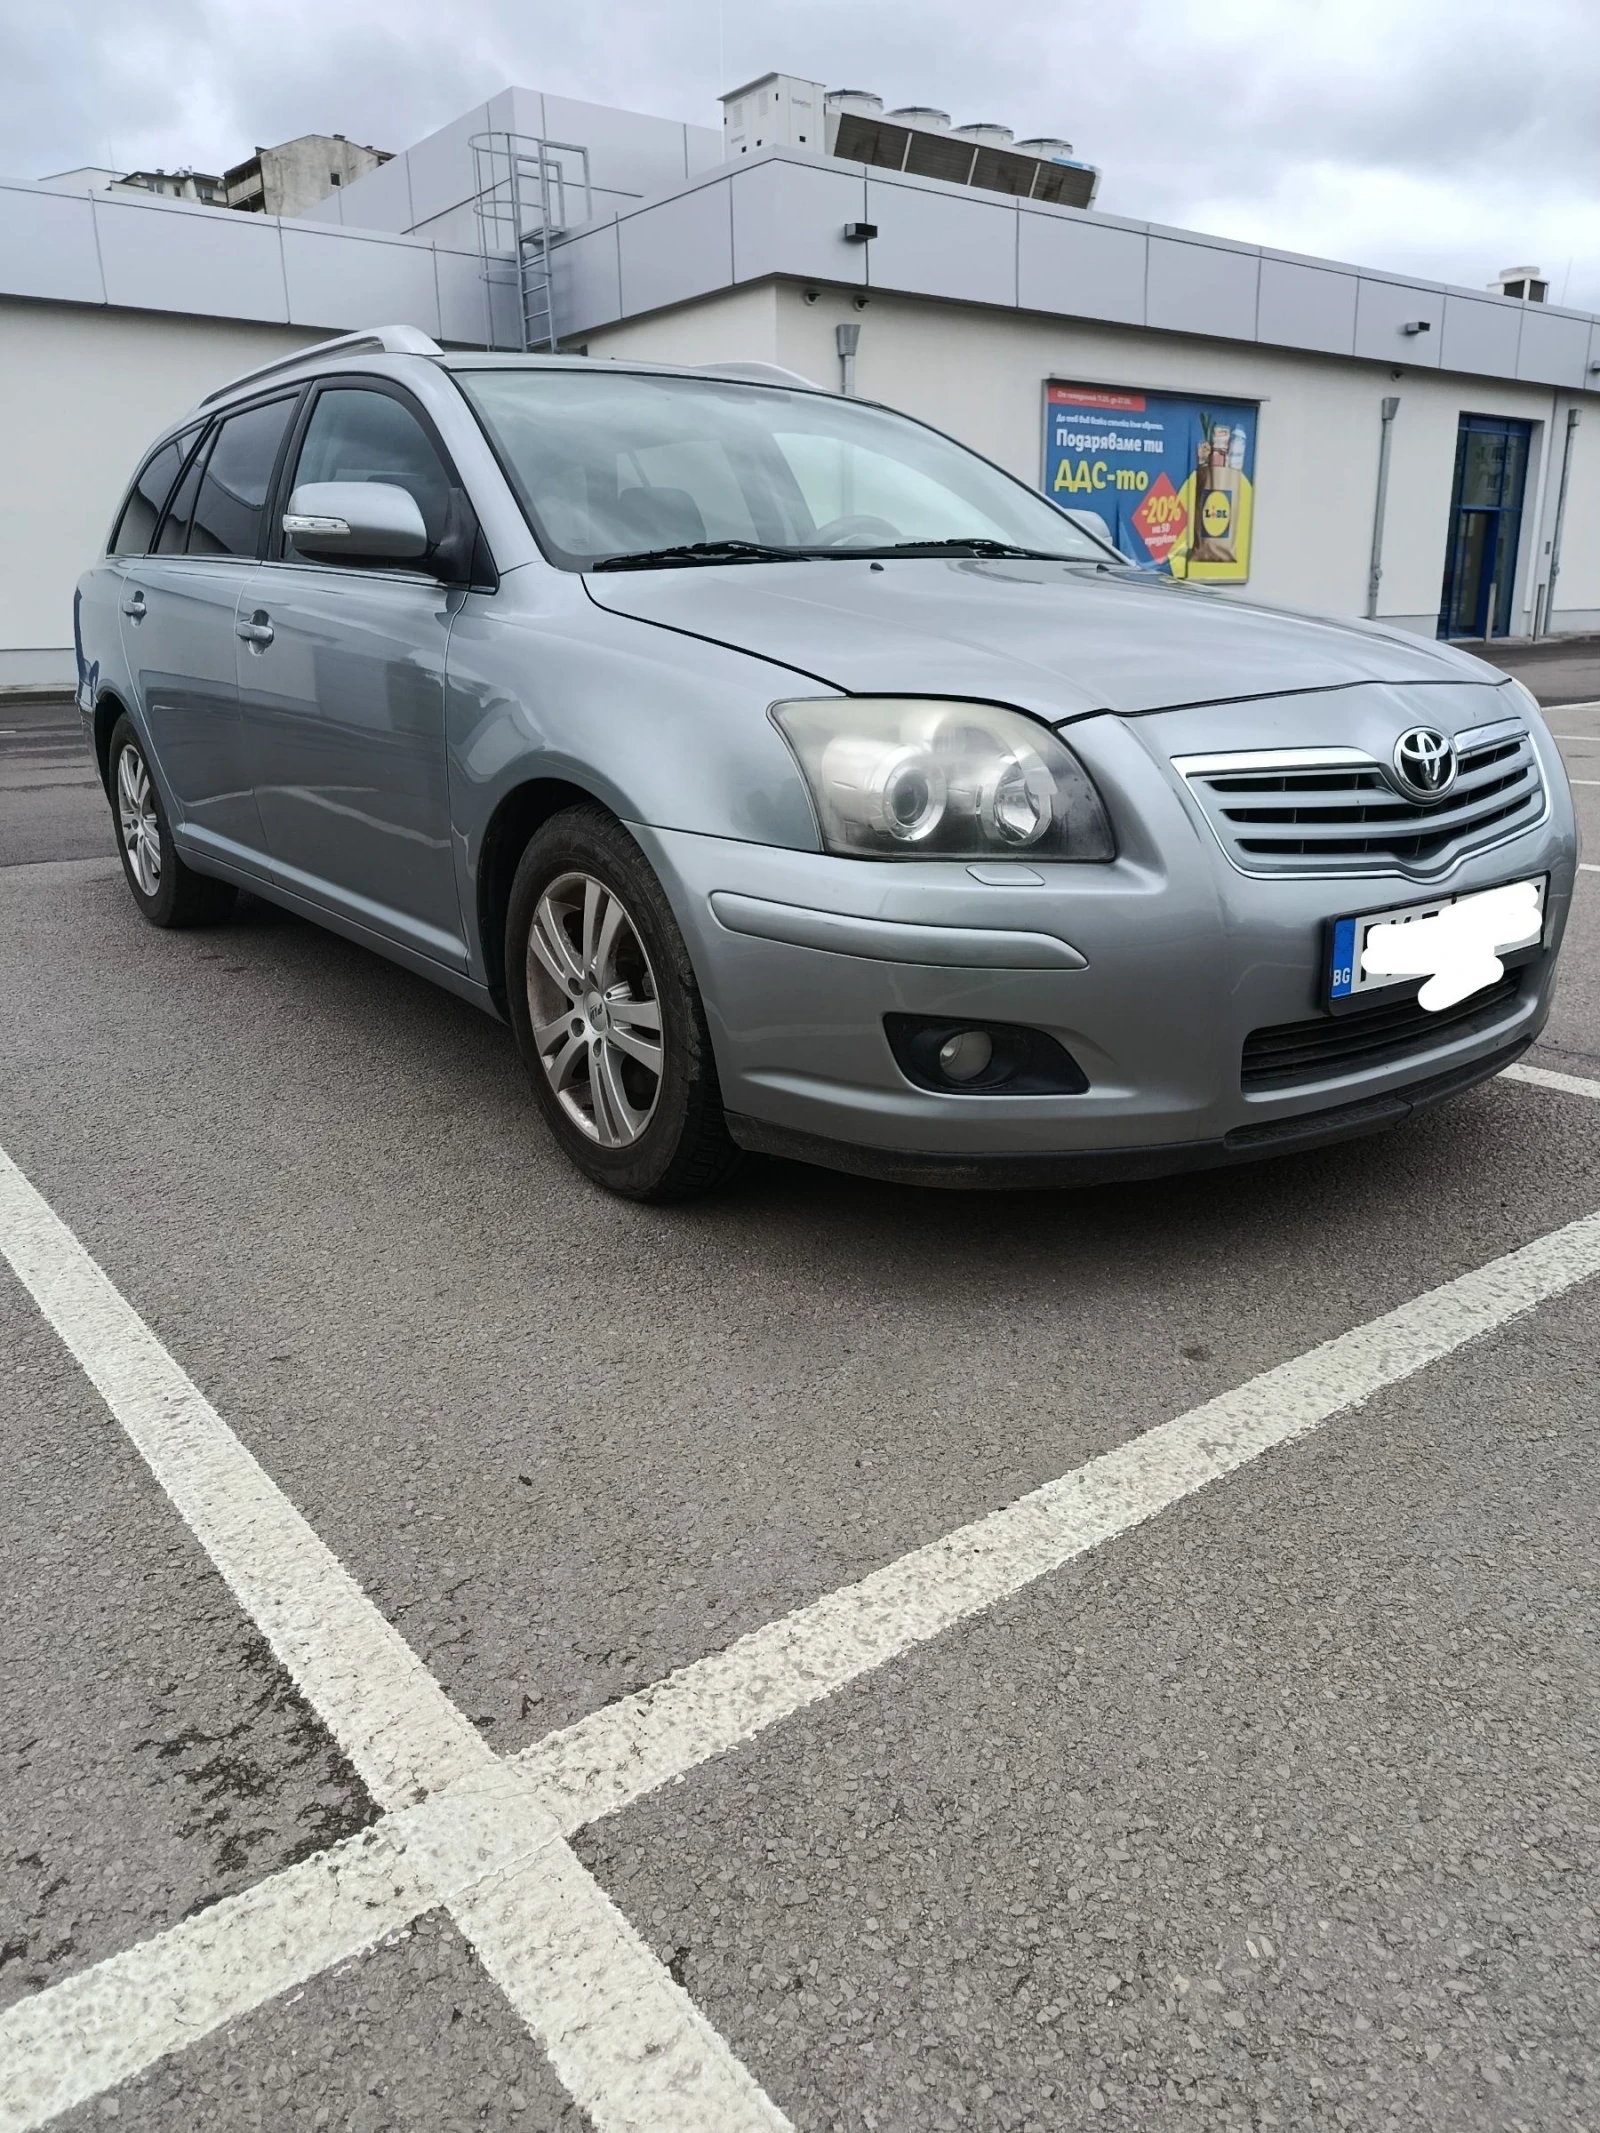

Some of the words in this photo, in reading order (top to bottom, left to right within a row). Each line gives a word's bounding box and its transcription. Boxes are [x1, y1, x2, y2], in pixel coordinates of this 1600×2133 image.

[1056, 428, 1141, 453] Подаряваме
[1143, 439, 1164, 453] ти
[1054, 458, 1149, 493] ДДС-то
[1141, 495, 1182, 524] -20%
[1332, 967, 1352, 987] BG
